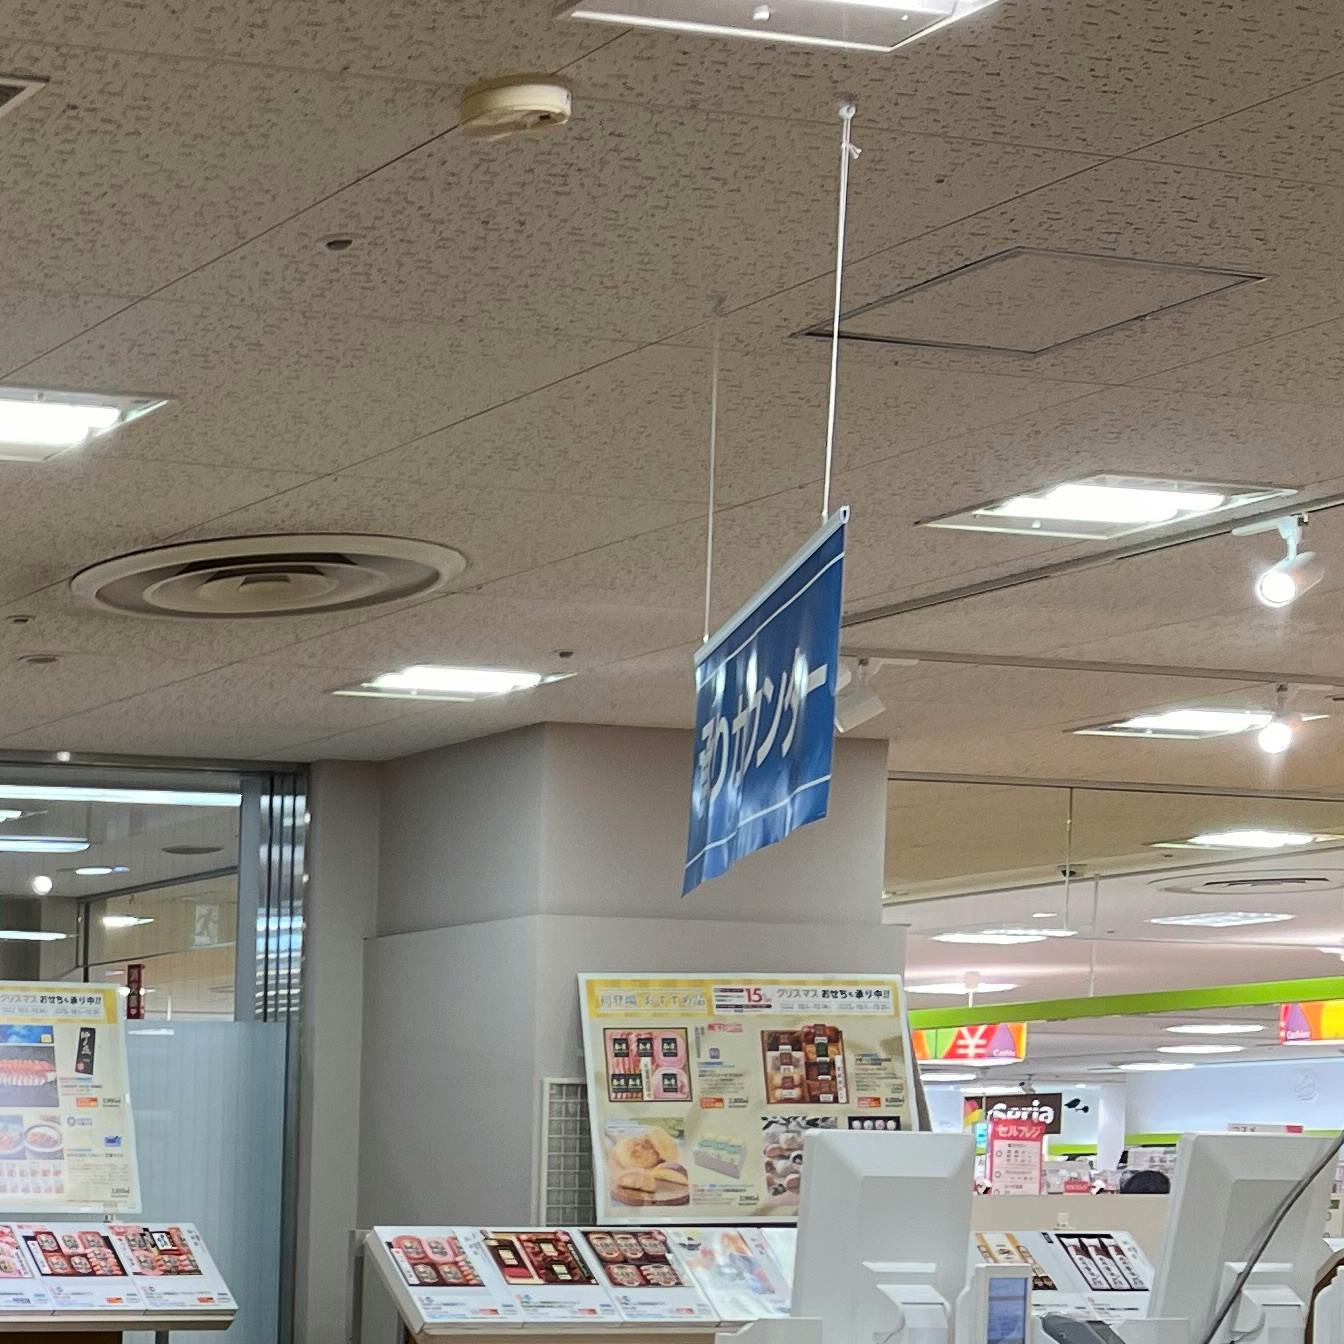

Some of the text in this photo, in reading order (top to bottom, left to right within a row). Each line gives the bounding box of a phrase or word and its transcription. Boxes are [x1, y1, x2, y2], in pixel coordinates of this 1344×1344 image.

[776, 988, 818, 998] クリスマス
